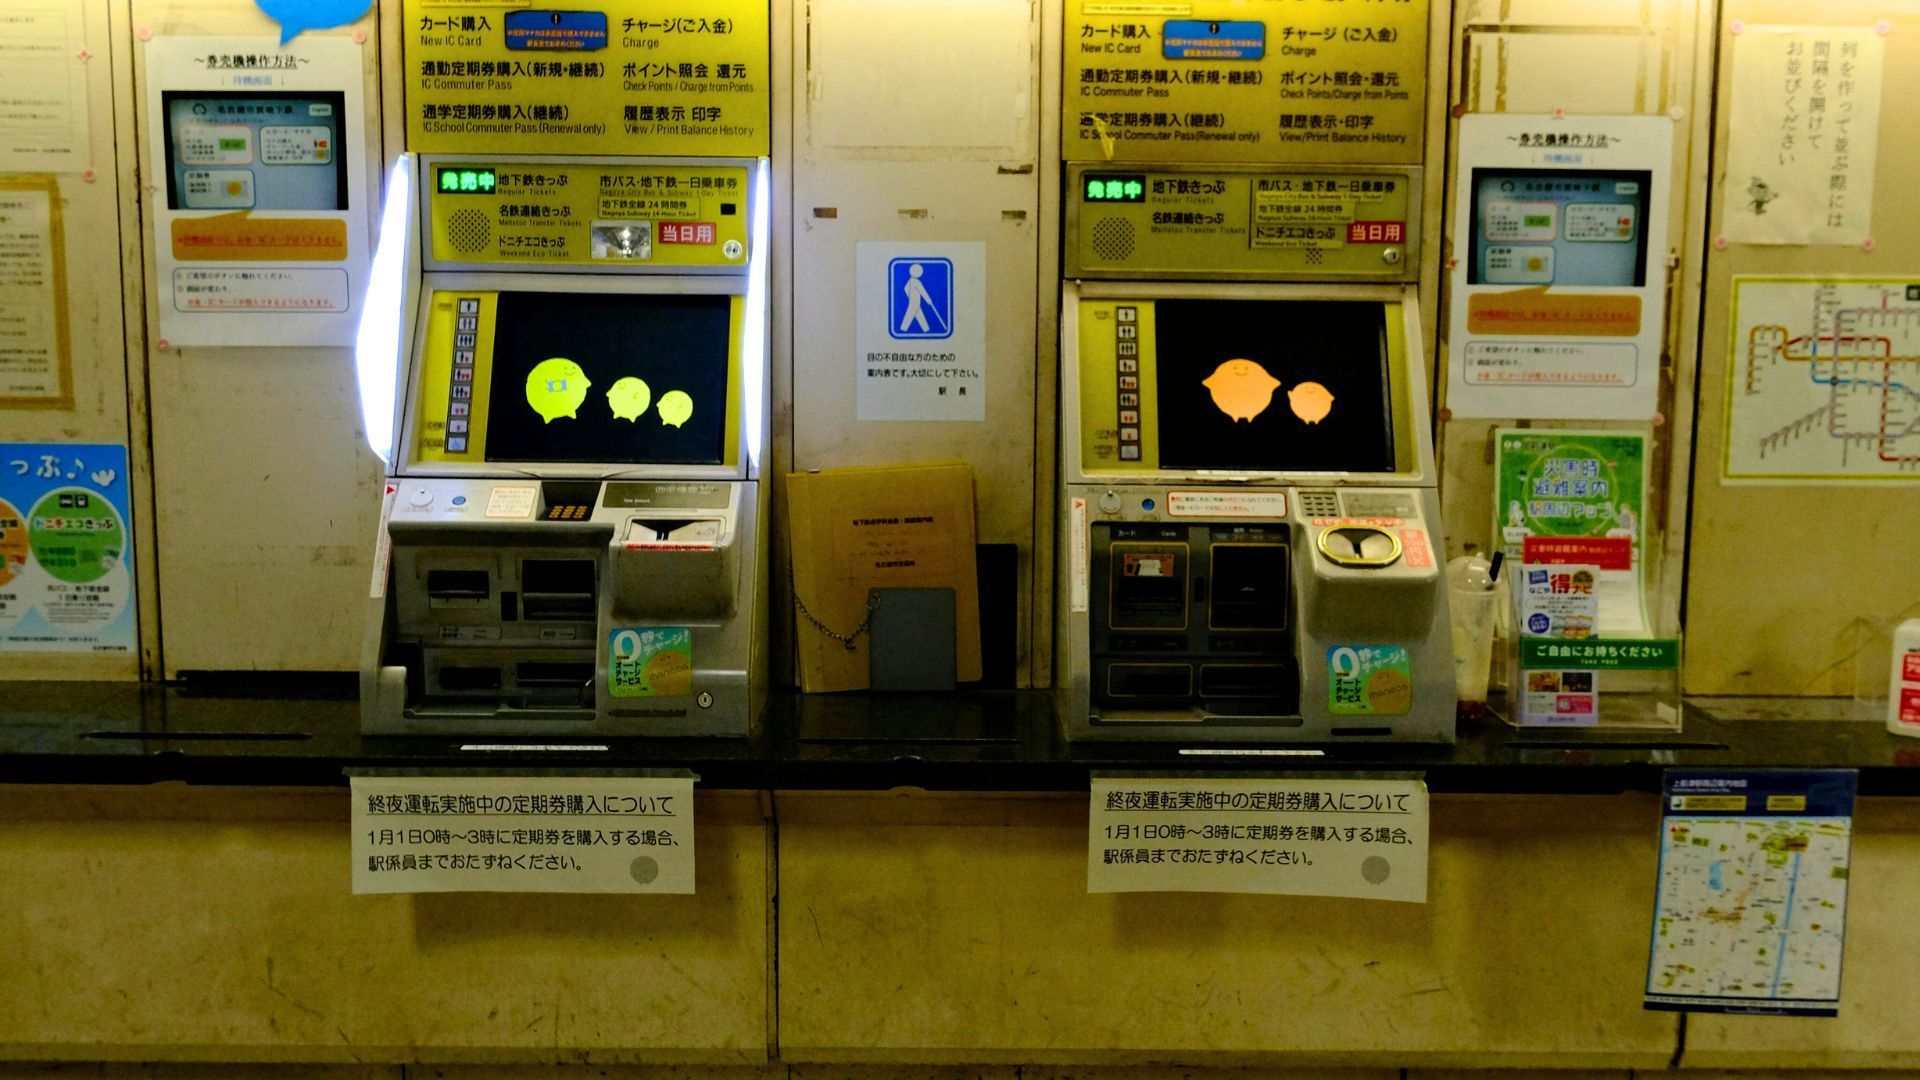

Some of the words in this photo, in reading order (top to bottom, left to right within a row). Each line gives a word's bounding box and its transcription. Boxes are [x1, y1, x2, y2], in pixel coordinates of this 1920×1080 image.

[420, 16, 491, 32] カード購入
[622, 18, 733, 34] チャージ(ご入金)
[1081, 24, 1150, 39] カード購入
[421, 36, 442, 46] New
[445, 36, 455, 46] IC
[458, 36, 481, 46] Card
[623, 37, 659, 49] Charge
[1081, 43, 1100, 53] New
[1103, 43, 1114, 53] IC
[1117, 44, 1141, 54] Card
[1281, 45, 1317, 58] Charge
[422, 61, 605, 78] 通勤定期券購入(新規・継続)
[623, 63, 708, 78] ポイント照会
[717, 64, 746, 79] 還元
[1080, 69, 1263, 85] 通勤定期券購入(新規・継続)
[1281, 71, 1400, 87] ポイント照会・還元
[421, 79, 431, 90] IC
[434, 79, 485, 90] Commuter
[488, 80, 513, 90] Pass
[624, 81, 647, 92] Check
[649, 81, 673, 92] Points
[680, 82, 708, 94] Charge
[709, 83, 729, 93] from
[729, 83, 754, 93] Points
[1080, 87, 1090, 97] IC
[1093, 87, 1144, 97] Commuter
[1147, 87, 1170, 98] Pass
[1281, 89, 1305, 98] Check
[1364, 90, 1383, 99] from
[1385, 90, 1409, 100] Points
[1808, 41, 1831, 150] 間隔を開けて
[1779, 41, 1803, 166] お並びください
[423, 105, 569, 121] 通学定期券購入(継続)
[624, 105, 685, 121] 履歴表示
[692, 107, 721, 122] 印字
[1280, 114, 1374, 129] 履歴表示・印字
[423, 123, 432, 133] IC
[434, 123, 465, 133] School
[466, 123, 513, 134] Commuter
[514, 124, 538, 134] Pass
[539, 124, 582, 135] (Renewal
[583, 124, 606, 136] only)
[625, 125, 648, 135] View
[657, 125, 679, 135] Print
[681, 125, 718, 136] Balance
[719, 126, 754, 137] History
[1079, 130, 1089, 139] IC
[1124, 130, 1171, 140] Commuter
[1238, 132, 1260, 143] only)
[1827, 41, 1858, 228] 列を作って並ぶ際には
[1280, 132, 1329, 143] View/Print
[1332, 132, 1369, 143] Balance
[1372, 132, 1407, 145] History
[442, 171, 495, 191] 発売中
[498, 174, 568, 187] 地下鉄きっぷ
[600, 176, 738, 189] 市バス・地下鉄一日乗車券
[1152, 179, 1226, 195] 地下鉄きっぷ
[1258, 180, 1396, 193] 市バス・地下鉄一日乗車券
[498, 189, 525, 197] Regular
[1088, 180, 1142, 200] 発売中
[499, 204, 571, 217] 名鉄連絡きっぷ
[602, 200, 646, 209] 地下鉄全線
[648, 201, 659, 209] 24
[661, 201, 687, 209] 時間券
[1304, 205, 1315, 213] 24
[1152, 212, 1225, 225] 名鉄連絡きっぷ
[663, 224, 712, 243] 当日用
[1256, 226, 1336, 240] ドニチエコきっぷ
[1352, 224, 1401, 241] 当日用
[499, 235, 566, 248] ドニチエコきっぷ
[866, 352, 956, 363] 目の不自由な方のための
[1544, 458, 1599, 477] 災害時
[1533, 479, 1609, 497] 避難案内
[1536, 645, 1664, 658] ご自由にお持ちください
[616, 661, 641, 670] オート
[616, 669, 641, 678] チャージ
[616, 677, 641, 686] サービス
[368, 793, 675, 815] 終夜運転実施中の定期券購入について
[1106, 790, 1411, 812] 終夜運転実施中の定期券購入について
[367, 829, 679, 848] 1月1日0時～3時に定期券を購入する場合、
[1104, 824, 1414, 846] 1月1日0時～3時に定期券を購入する場合、
[367, 854, 583, 873] 駅係員までおたずねください。
[1103, 848, 1313, 867] 駅係員までおたずねください。
